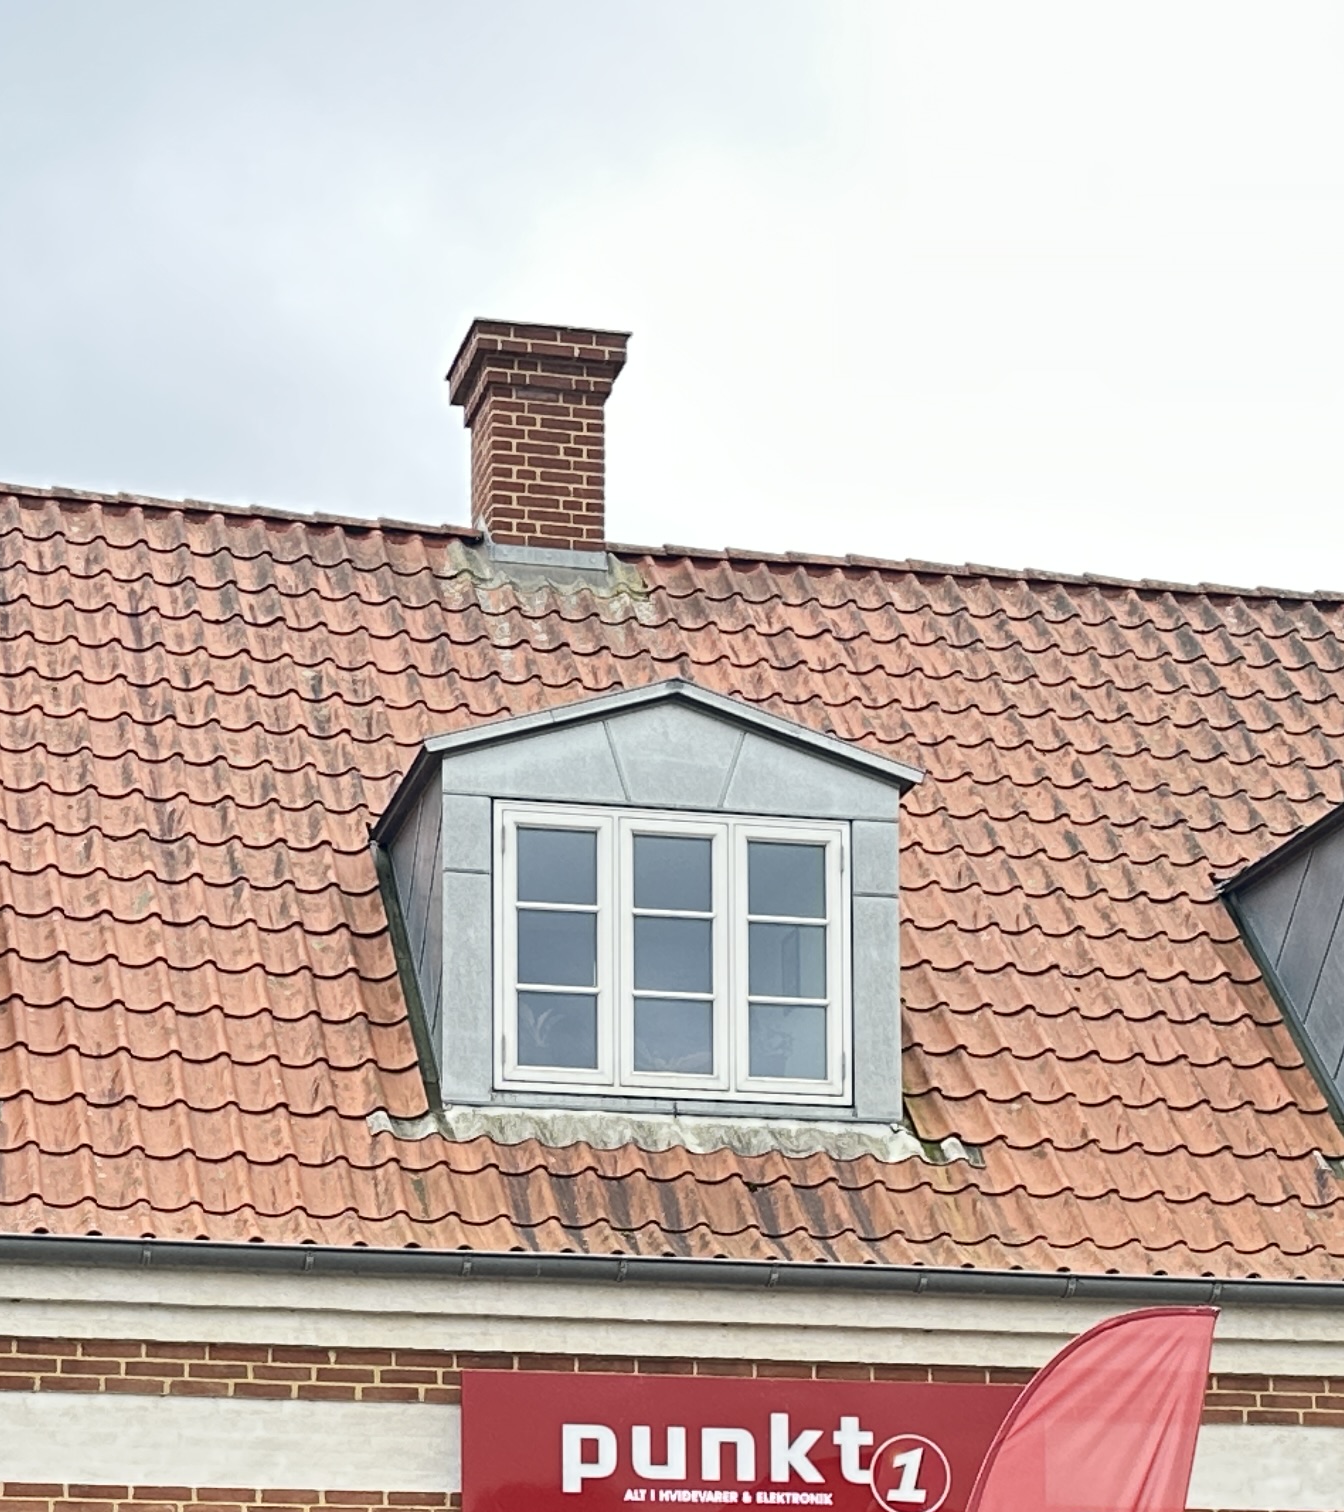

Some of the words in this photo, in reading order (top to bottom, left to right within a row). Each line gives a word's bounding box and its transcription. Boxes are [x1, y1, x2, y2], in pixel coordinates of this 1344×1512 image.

[623, 1488, 647, 1502] ALT
[650, 1489, 656, 1502] I
[658, 1489, 739, 1504] HVIDEVARER
[742, 1491, 752, 1504] &
[756, 1491, 834, 1506] ELEKTRONIK
